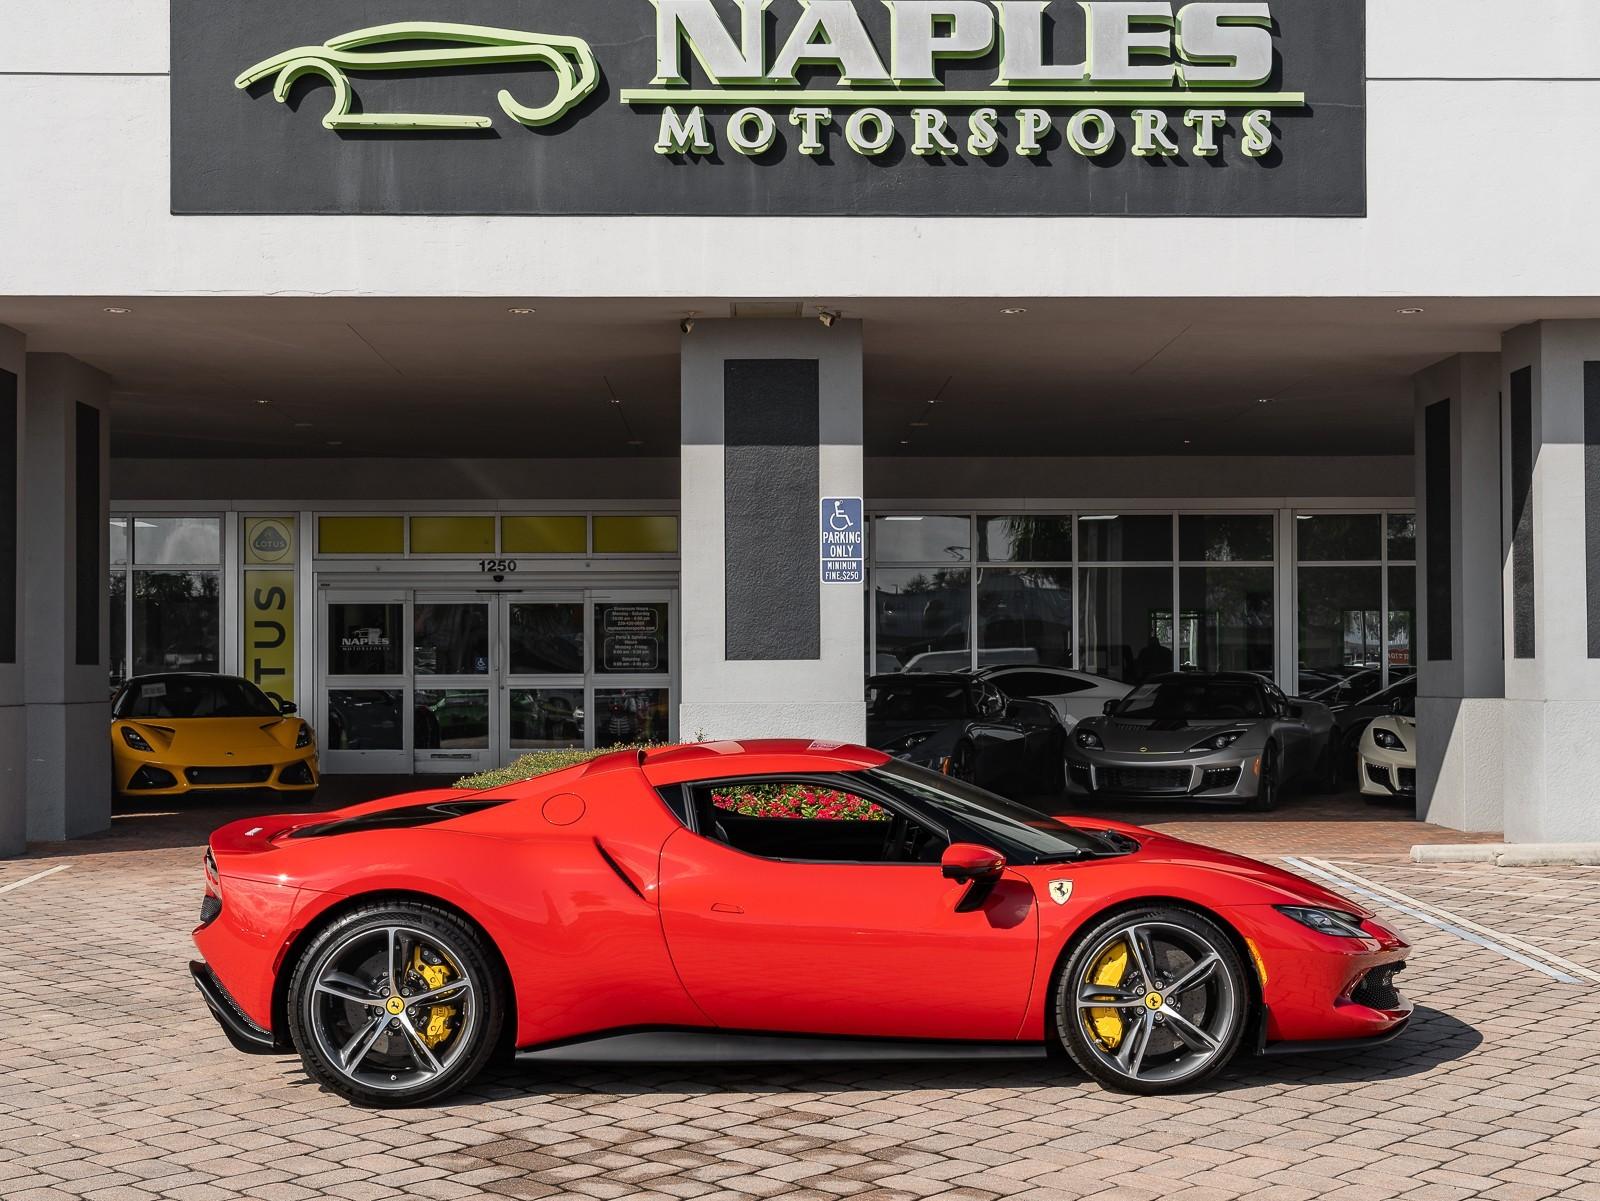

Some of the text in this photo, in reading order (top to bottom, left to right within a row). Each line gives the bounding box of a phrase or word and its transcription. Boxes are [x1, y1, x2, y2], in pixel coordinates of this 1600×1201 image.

[649, 0, 1274, 88] NAPLES
[653, 106, 1273, 157] MOTORSPORTS
[823, 532, 861, 543] PARKING
[255, 540, 285, 548] LOTUS
[830, 545, 854, 557] ONLY
[479, 560, 517, 572] 1250
[827, 561, 857, 570] MINIMUM
[825, 571, 859, 580] FINE $250
[342, 638, 390, 646] NAPLES
[254, 586, 287, 714] TUS
